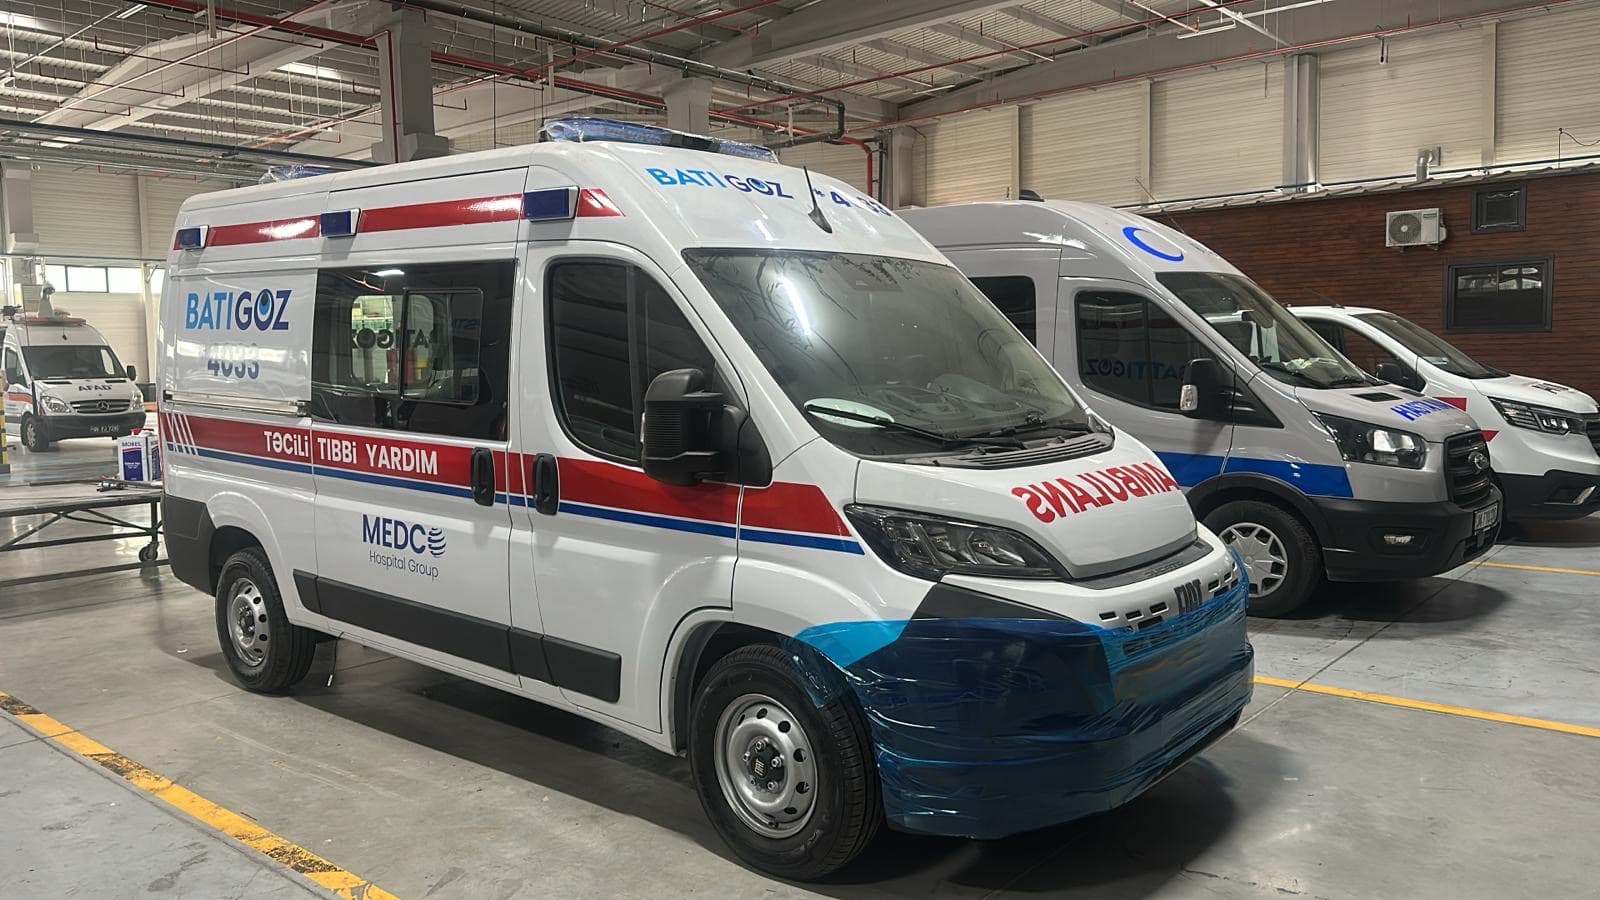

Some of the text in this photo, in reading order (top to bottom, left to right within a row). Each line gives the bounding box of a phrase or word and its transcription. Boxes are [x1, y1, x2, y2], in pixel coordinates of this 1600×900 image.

[365, 443, 438, 475] YARDIM
[369, 550, 439, 580] Hospital Group
